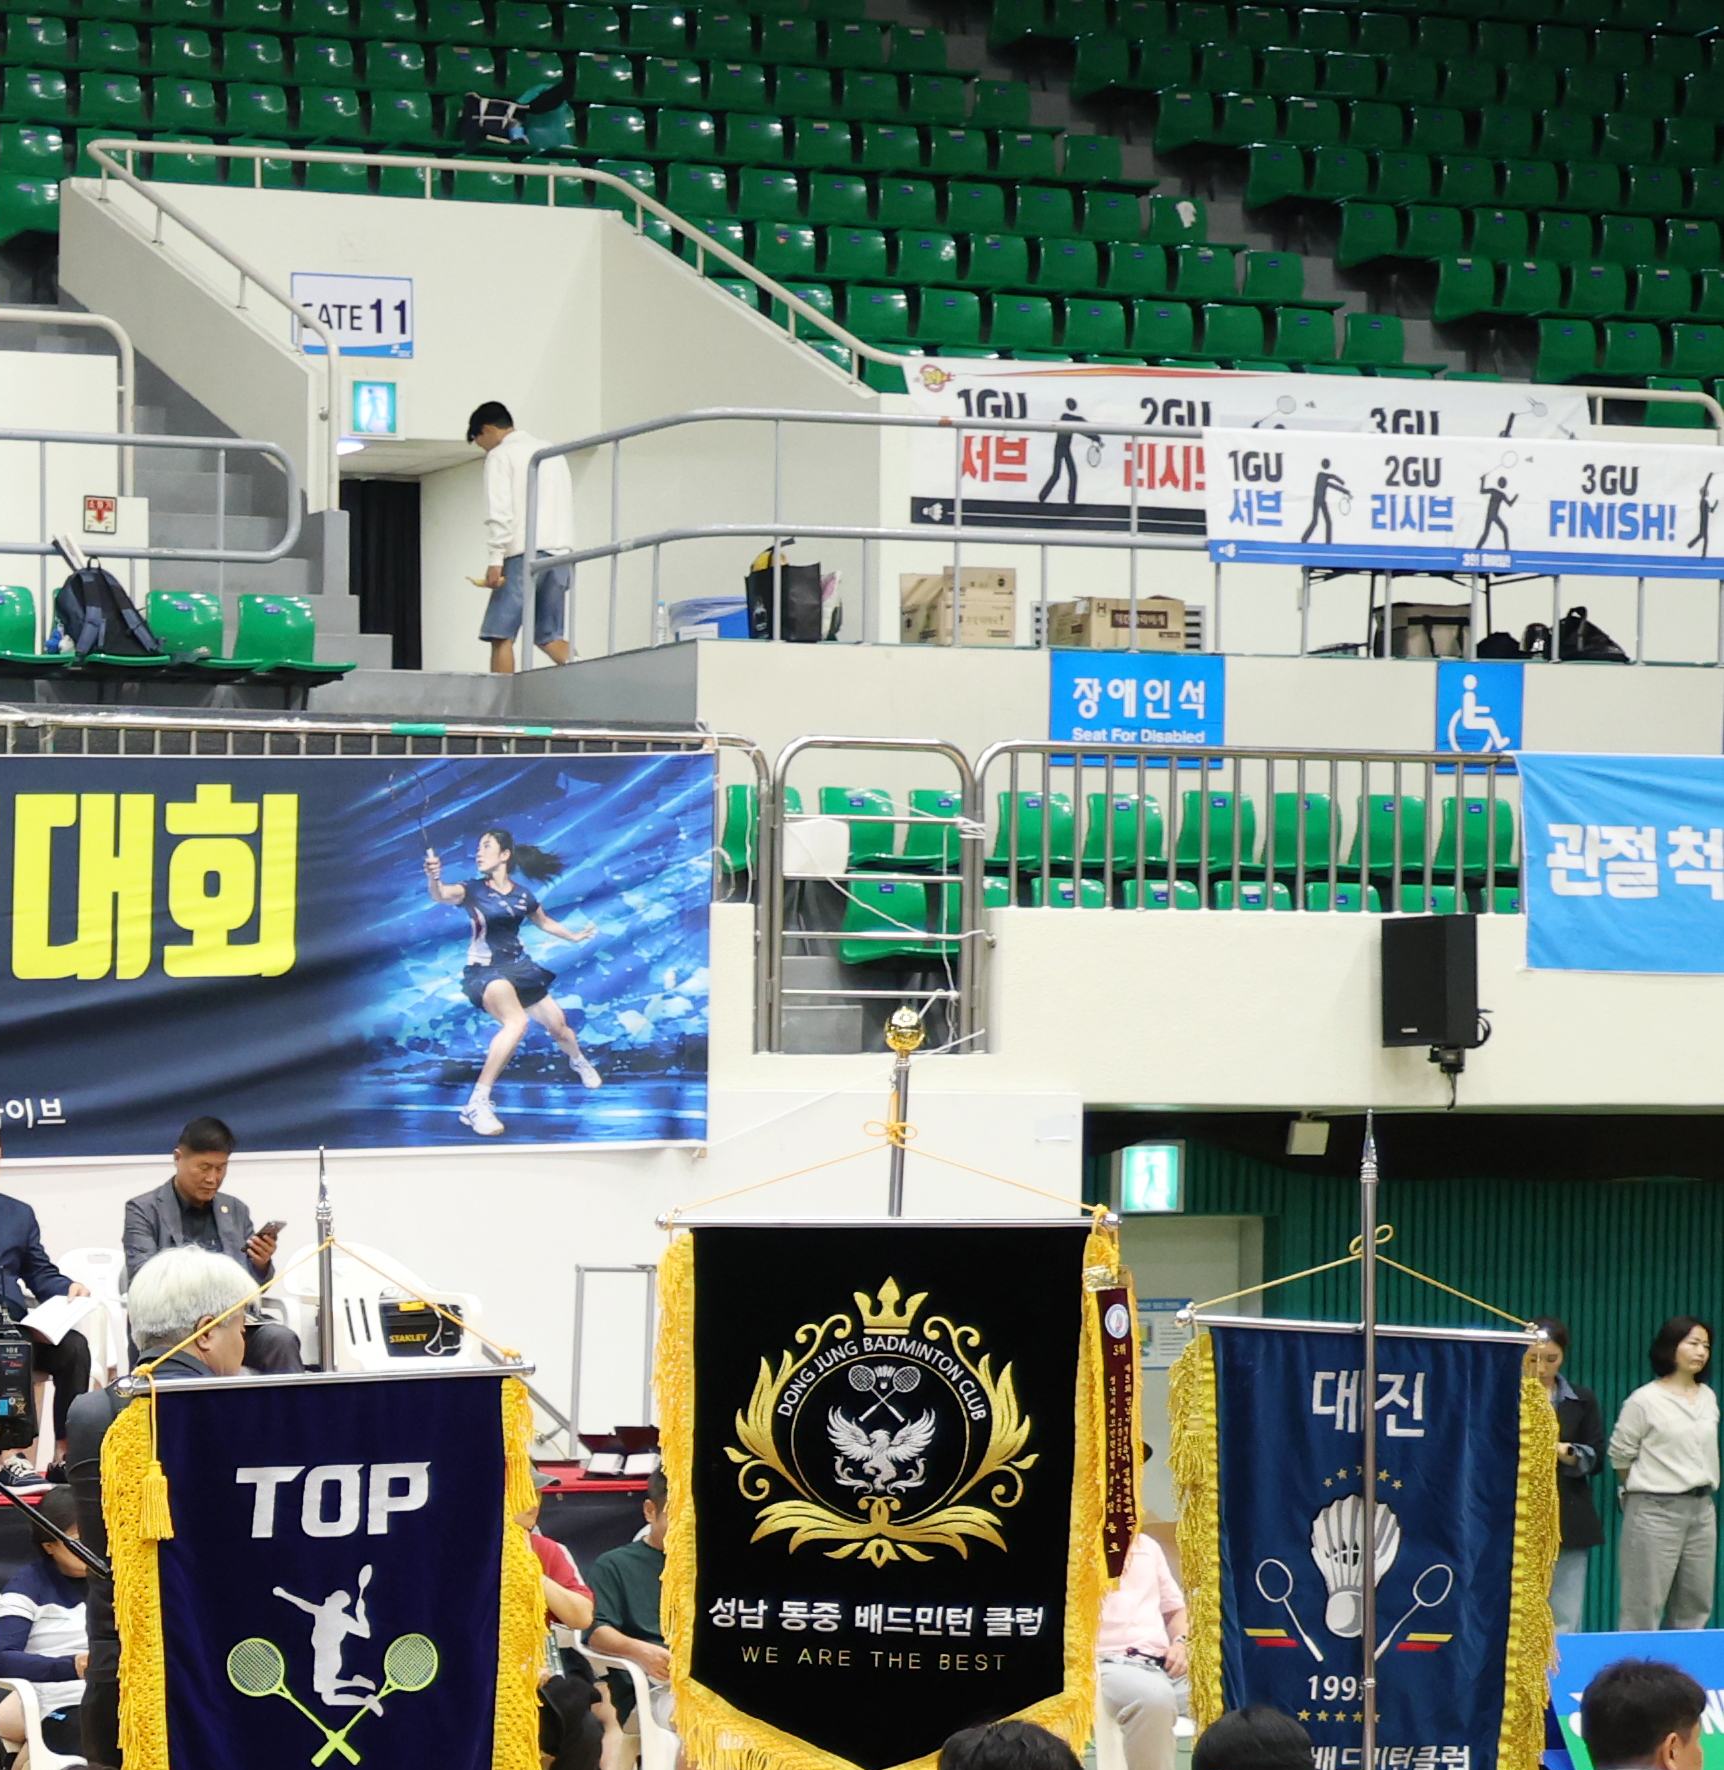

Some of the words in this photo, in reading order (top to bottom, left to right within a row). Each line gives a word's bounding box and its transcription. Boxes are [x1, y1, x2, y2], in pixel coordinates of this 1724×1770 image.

[369, 298, 407, 335] 11
[1228, 450, 1283, 484] 1GU
[1384, 456, 1442, 488] 2GU
[1581, 464, 1640, 497] 3GU
[1228, 489, 1283, 527] 서브
[1371, 494, 1454, 533] 리시브
[1549, 501, 1678, 542] FINISH!
[1072, 677, 1206, 720] 장애인석
[1072, 727, 1108, 742] Seat
[1111, 728, 1138, 743] For
[1140, 729, 1206, 744] Disabled
[1546, 823, 1660, 899] 관절
[776, 1366, 817, 1418] DONG
[814, 1340, 860, 1376] JUNG
[861, 1335, 964, 1386] BADMINTON
[956, 1378, 988, 1422] CLUB
[1311, 1369, 1427, 1438] 대진
[234, 1461, 432, 1540] TOP
[708, 1597, 768, 1629] 성남
[778, 1599, 842, 1633] 동중
[854, 1603, 973, 1637] 배드민턴
[982, 1605, 1044, 1638] 클럽
[741, 1645, 779, 1664] WE
[797, 1647, 852, 1667] ARE
[871, 1650, 921, 1670] THE
[938, 1652, 1006, 1672] BEST
[1306, 1674, 1365, 1702] 199
